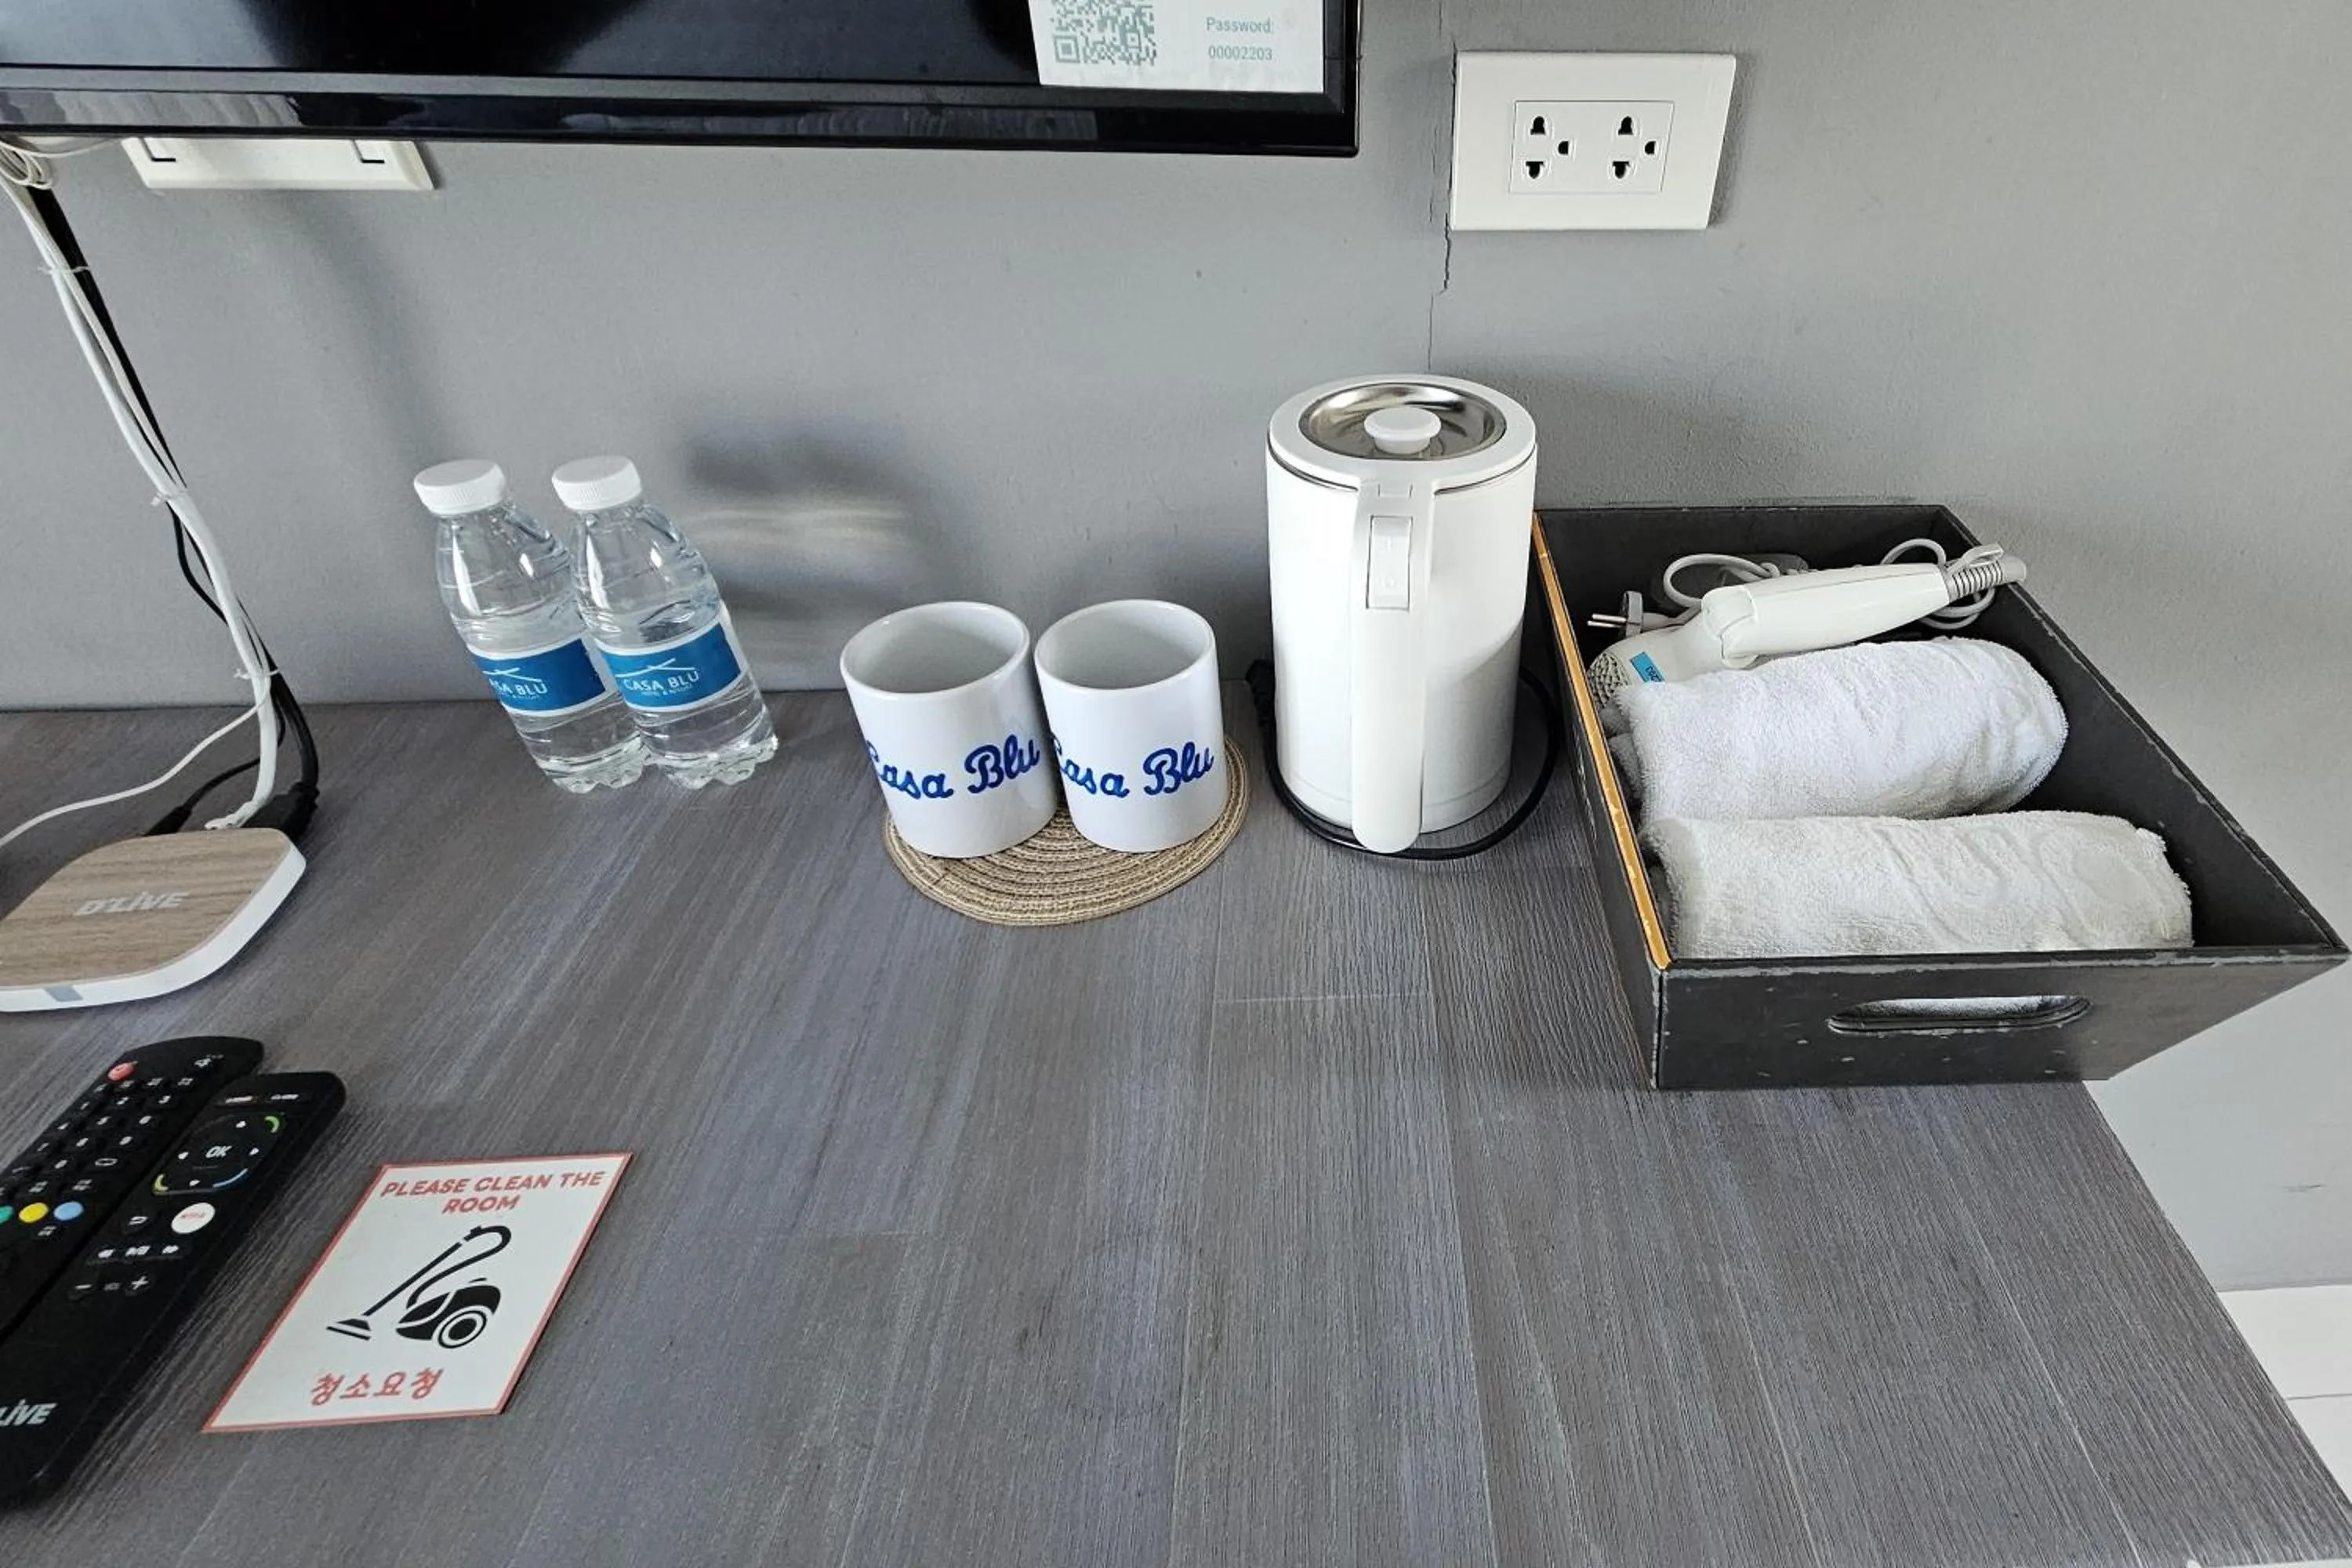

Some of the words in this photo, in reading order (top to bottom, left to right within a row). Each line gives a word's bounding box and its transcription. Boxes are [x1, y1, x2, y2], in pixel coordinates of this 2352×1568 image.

[1206, 16, 1274, 34] Password:
[1208, 45, 1273, 60] 00002203
[514, 683, 548, 695] BLU
[622, 677, 665, 691] CASA
[667, 670, 700, 688] BLU
[964, 734, 1040, 794] Blu
[1142, 741, 1214, 796] Blu
[205, 1145, 232, 1158] OK
[380, 1178, 470, 1197] PLEASE
[474, 1174, 554, 1192] CLEAN
[560, 1171, 607, 1188] THE
[441, 1195, 521, 1214] ROOM
[310, 1367, 445, 1406] 청소요청
